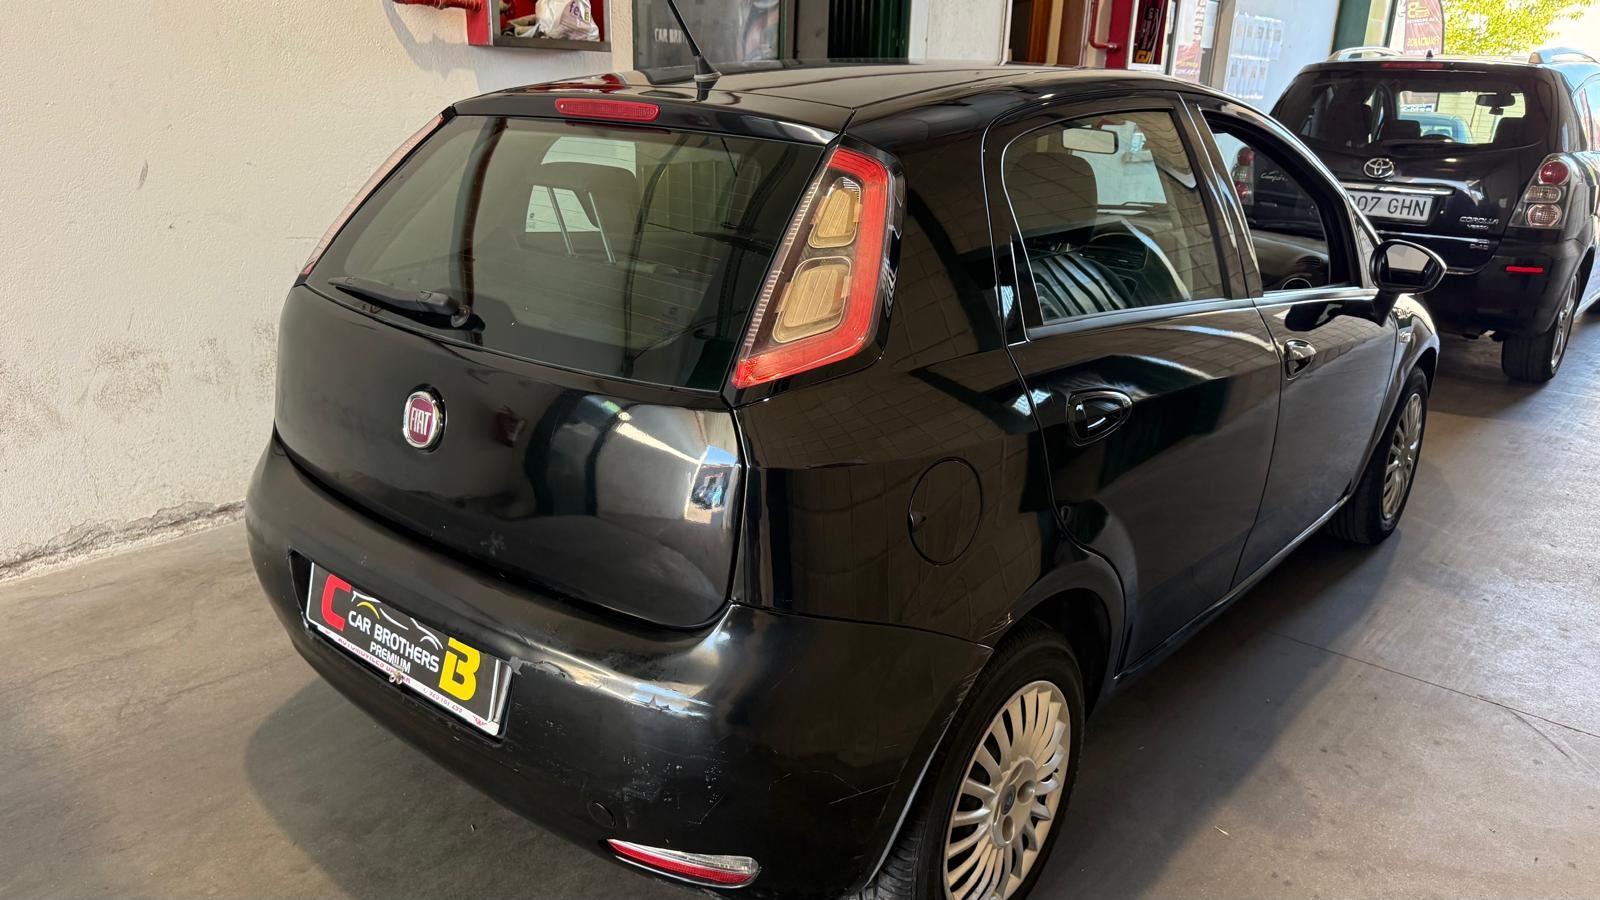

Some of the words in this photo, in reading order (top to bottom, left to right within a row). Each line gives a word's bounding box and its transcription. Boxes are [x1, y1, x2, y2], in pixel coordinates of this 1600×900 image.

[1387, 198, 1427, 217] GHN
[1459, 216, 1499, 225] COROLLA
[410, 407, 432, 436] FIAT
[321, 573, 352, 632] C
[348, 610, 371, 635] CAR
[373, 623, 440, 673] BROTHERS
[369, 640, 411, 674] PREMIUM
[438, 637, 481, 701] B
